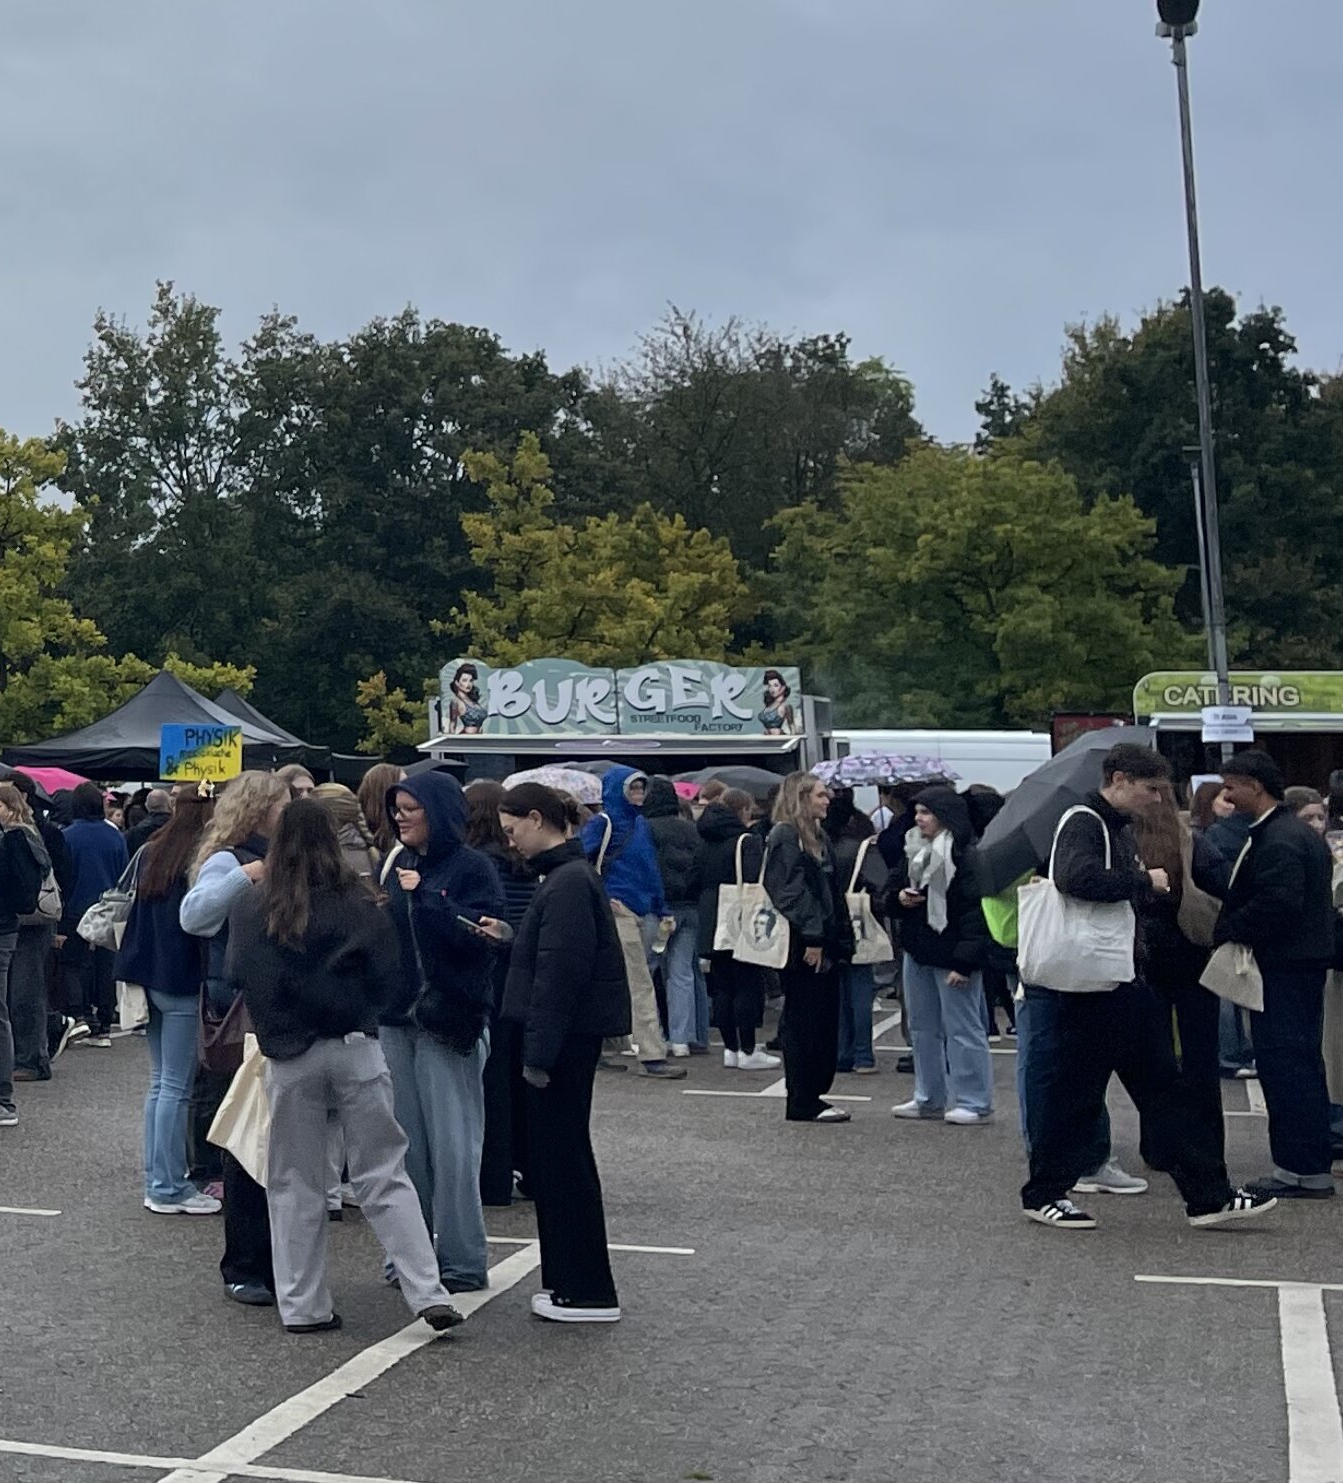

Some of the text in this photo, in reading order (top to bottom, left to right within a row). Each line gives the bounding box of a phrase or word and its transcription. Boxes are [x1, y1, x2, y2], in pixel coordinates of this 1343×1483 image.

[487, 665, 754, 725] BURGER
[630, 714, 701, 724] STREETFOOD
[694, 723, 744, 732] FACTORY
[184, 727, 238, 748] PHYSIK
[184, 758, 226, 780] Physik
